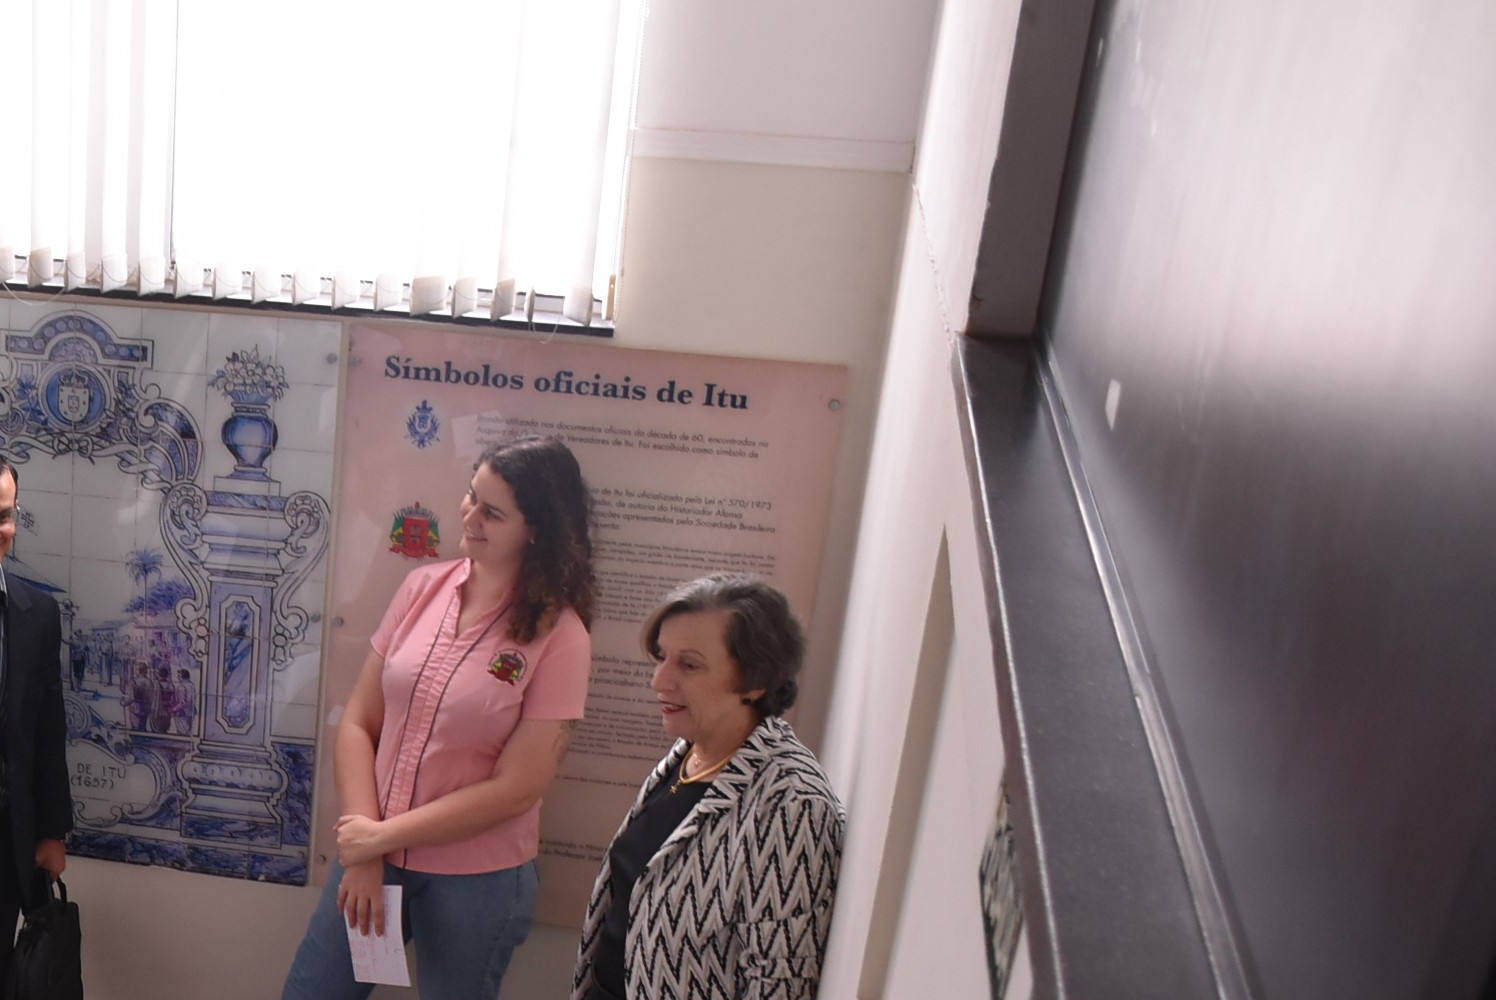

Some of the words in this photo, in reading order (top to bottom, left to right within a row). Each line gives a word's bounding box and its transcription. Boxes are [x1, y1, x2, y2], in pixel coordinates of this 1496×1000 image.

[384, 355, 523, 389] Símbolos
[533, 370, 646, 400] oficiais
[656, 379, 693, 404] de
[702, 382, 748, 409] Itu
[77, 762, 92, 776] DE
[102, 765, 126, 779] ITU
[70, 774, 114, 789] (1657)
